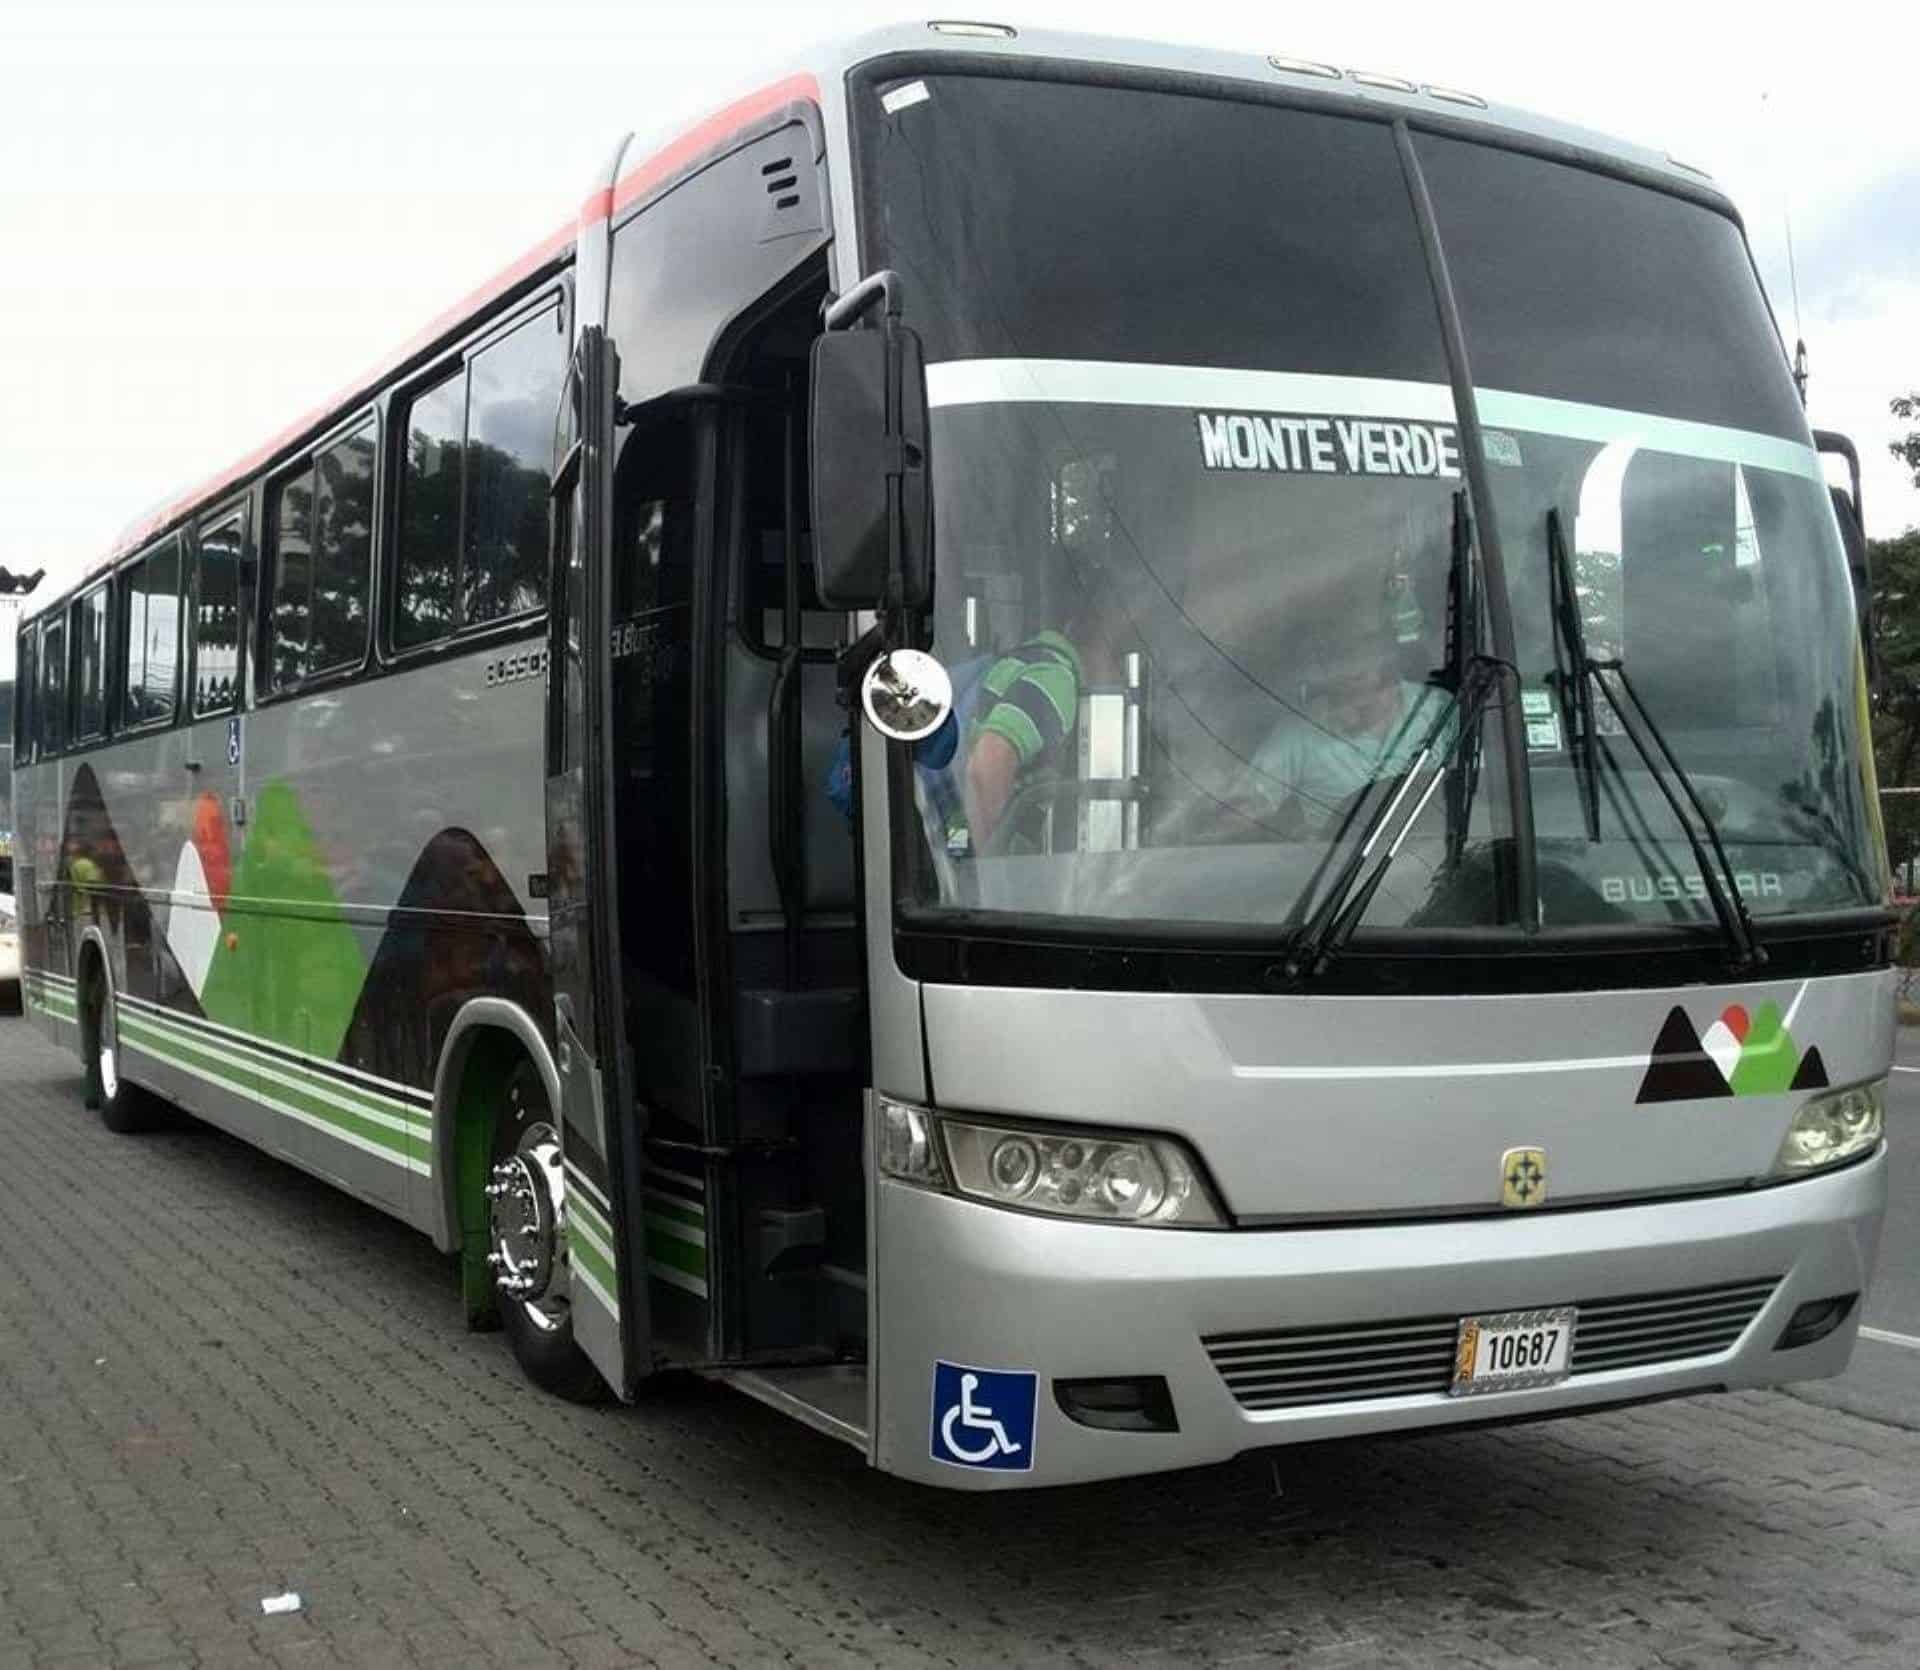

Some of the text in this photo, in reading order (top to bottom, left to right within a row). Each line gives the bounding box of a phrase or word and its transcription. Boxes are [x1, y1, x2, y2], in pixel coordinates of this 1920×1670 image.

[1199, 414, 1337, 473] MONTE
[1337, 420, 1462, 479] VERDE
[1489, 1329, 1559, 1371] 10687
